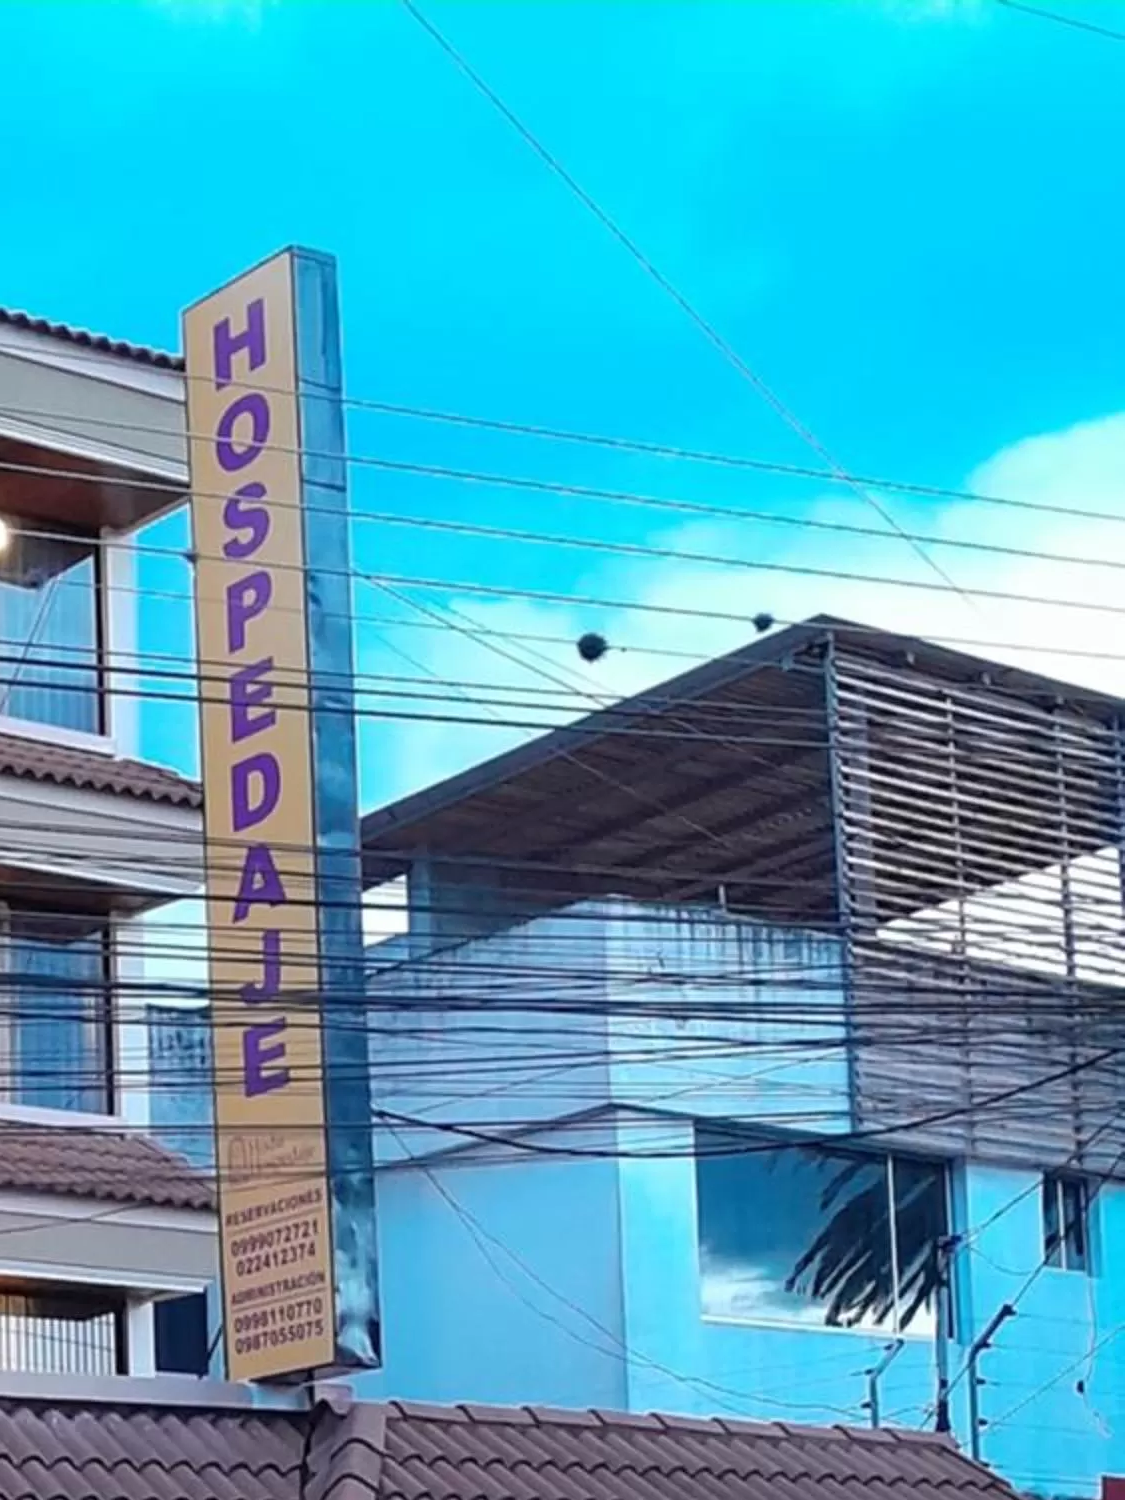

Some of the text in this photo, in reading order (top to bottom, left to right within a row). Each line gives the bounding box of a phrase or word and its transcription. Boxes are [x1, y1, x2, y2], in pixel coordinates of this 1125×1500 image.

[213, 298, 288, 1098] HOSPEDAJE
[226, 1189, 322, 1227] RESERVACIONES
[236, 1242, 315, 1276] 022412374
